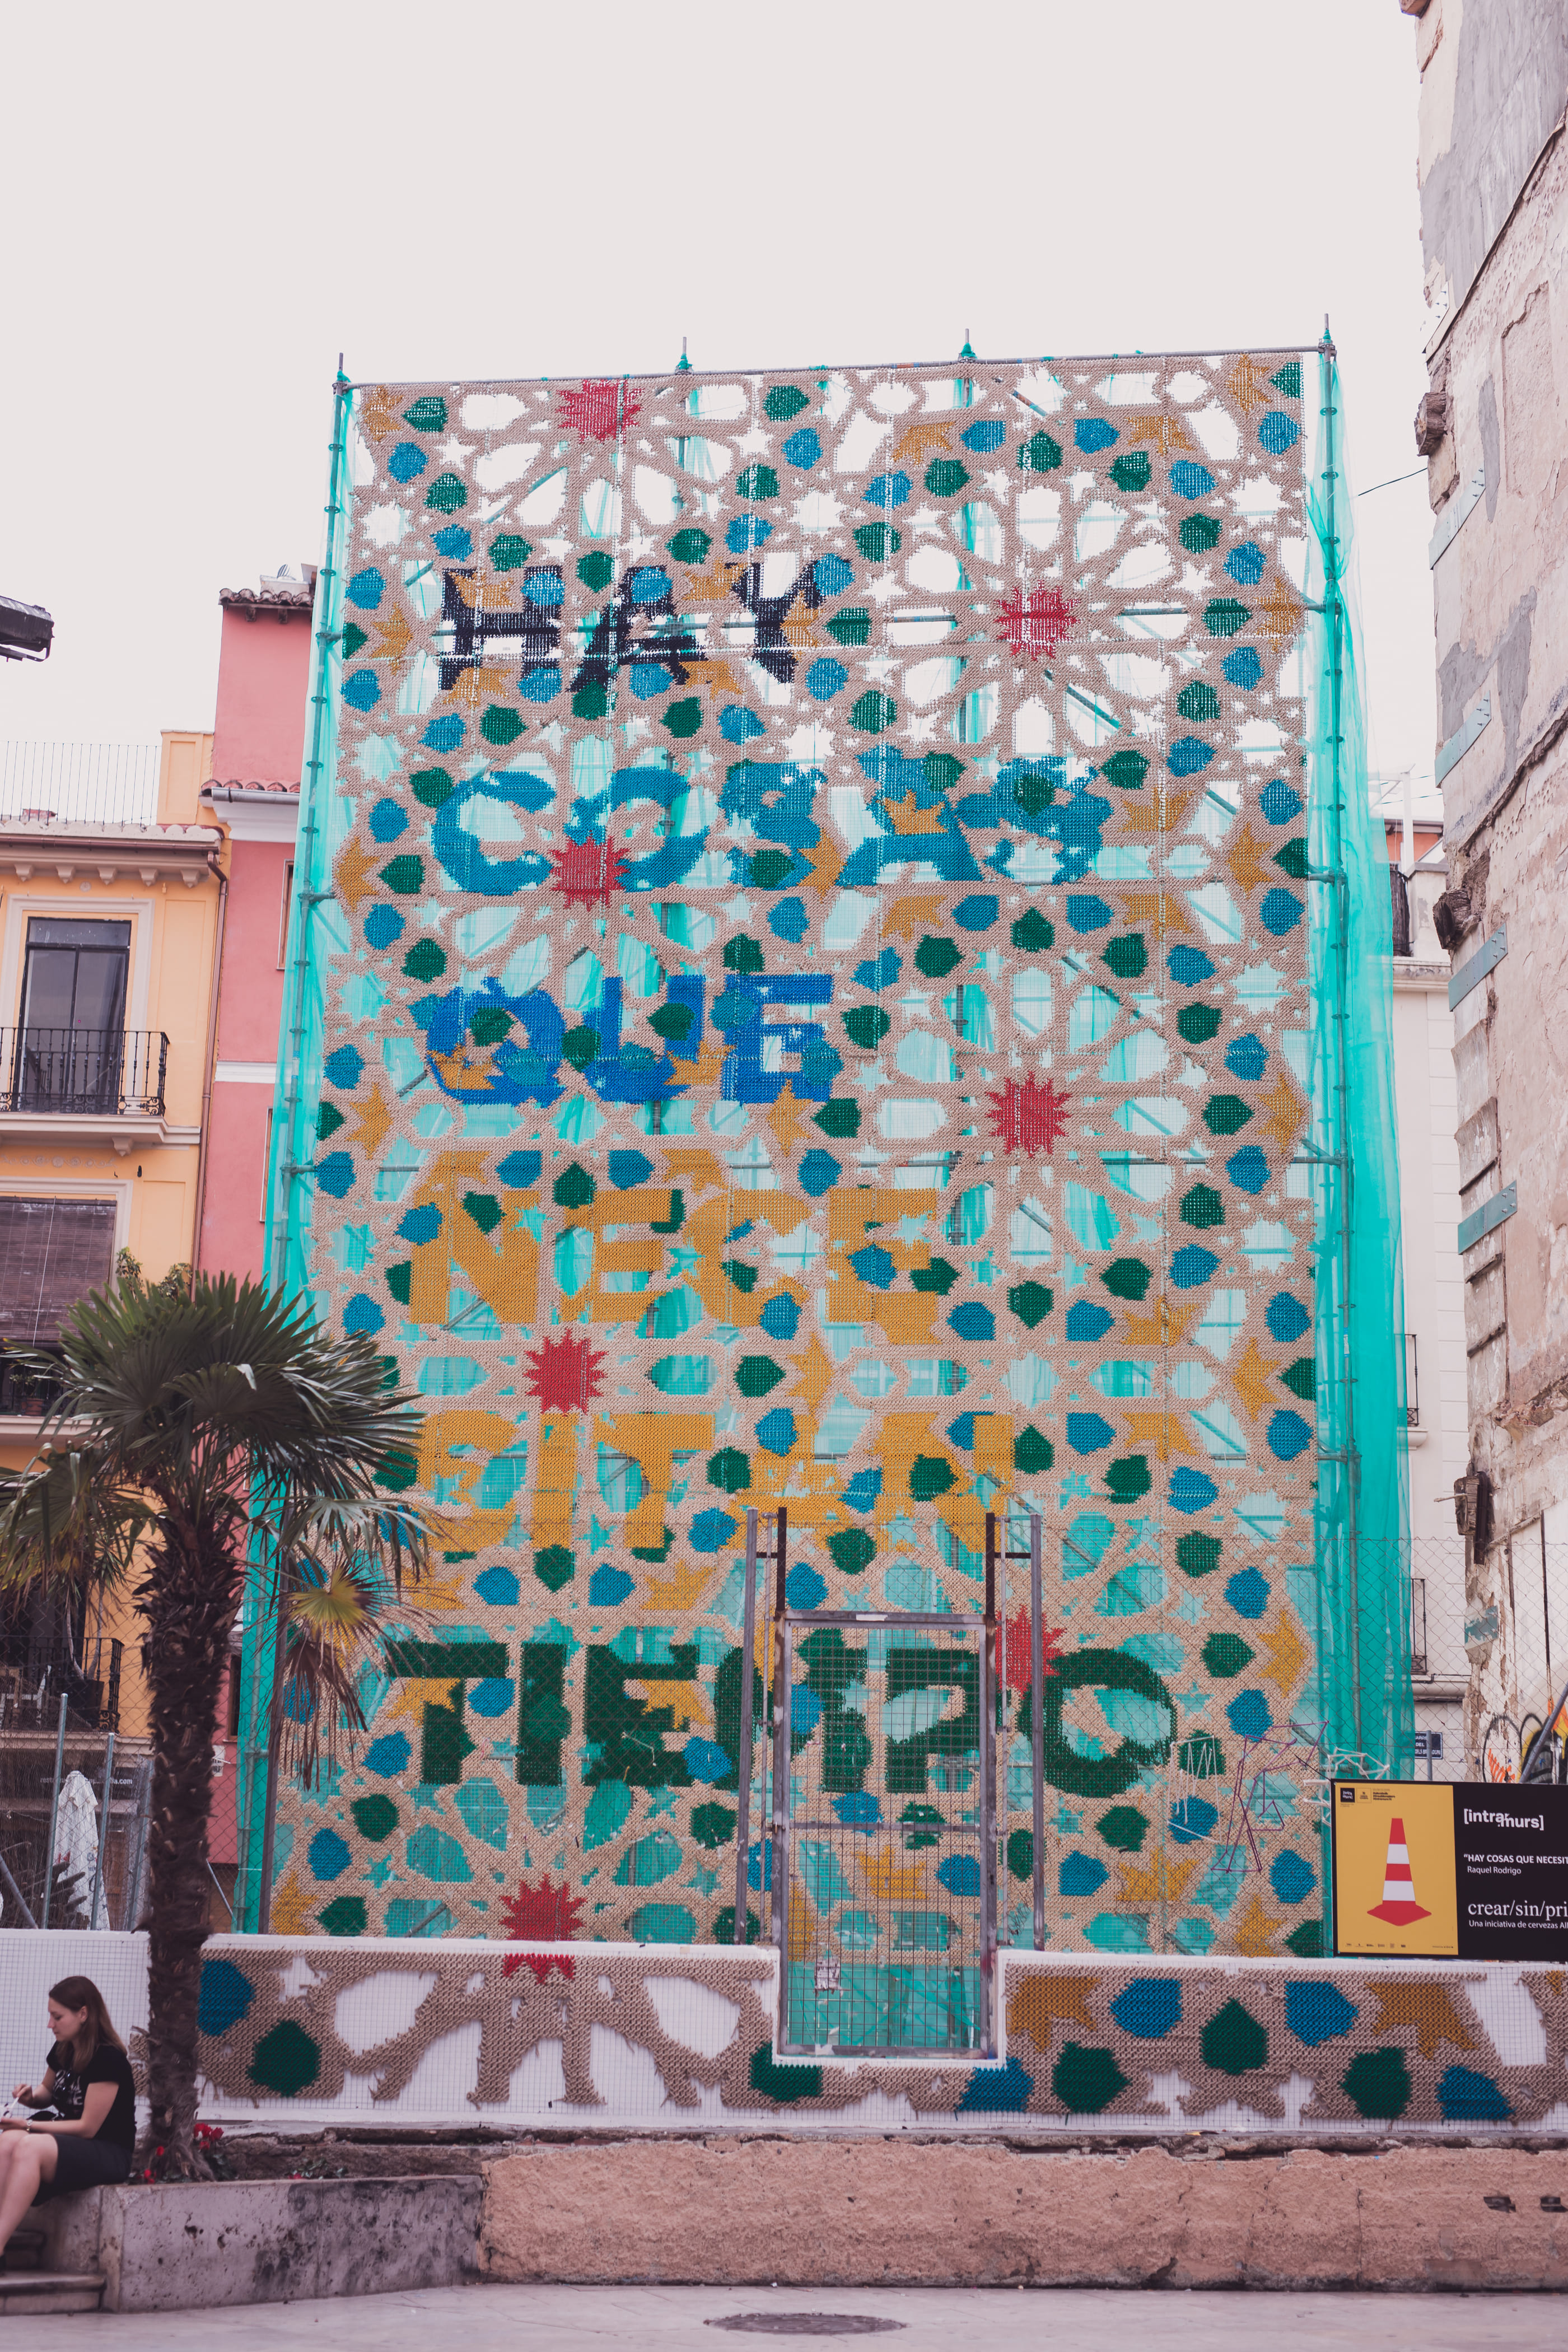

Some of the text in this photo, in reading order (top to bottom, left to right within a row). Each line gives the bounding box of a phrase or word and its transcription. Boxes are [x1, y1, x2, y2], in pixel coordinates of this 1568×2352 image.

[439, 560, 852, 690] HAY
[431, 757, 1112, 896] COSAS
[427, 974, 834, 1103] QUE
[410, 1187, 939, 1328] NECE
[385, 1641, 1178, 1798] TIEMPO
[1464, 1854, 1485, 1863] “HAY
[1487, 1855, 1514, 1863] COSAS
[1516, 1855, 1534, 1864] QUE
[1467, 1866, 1522, 1876] Raquel Rodrigo
